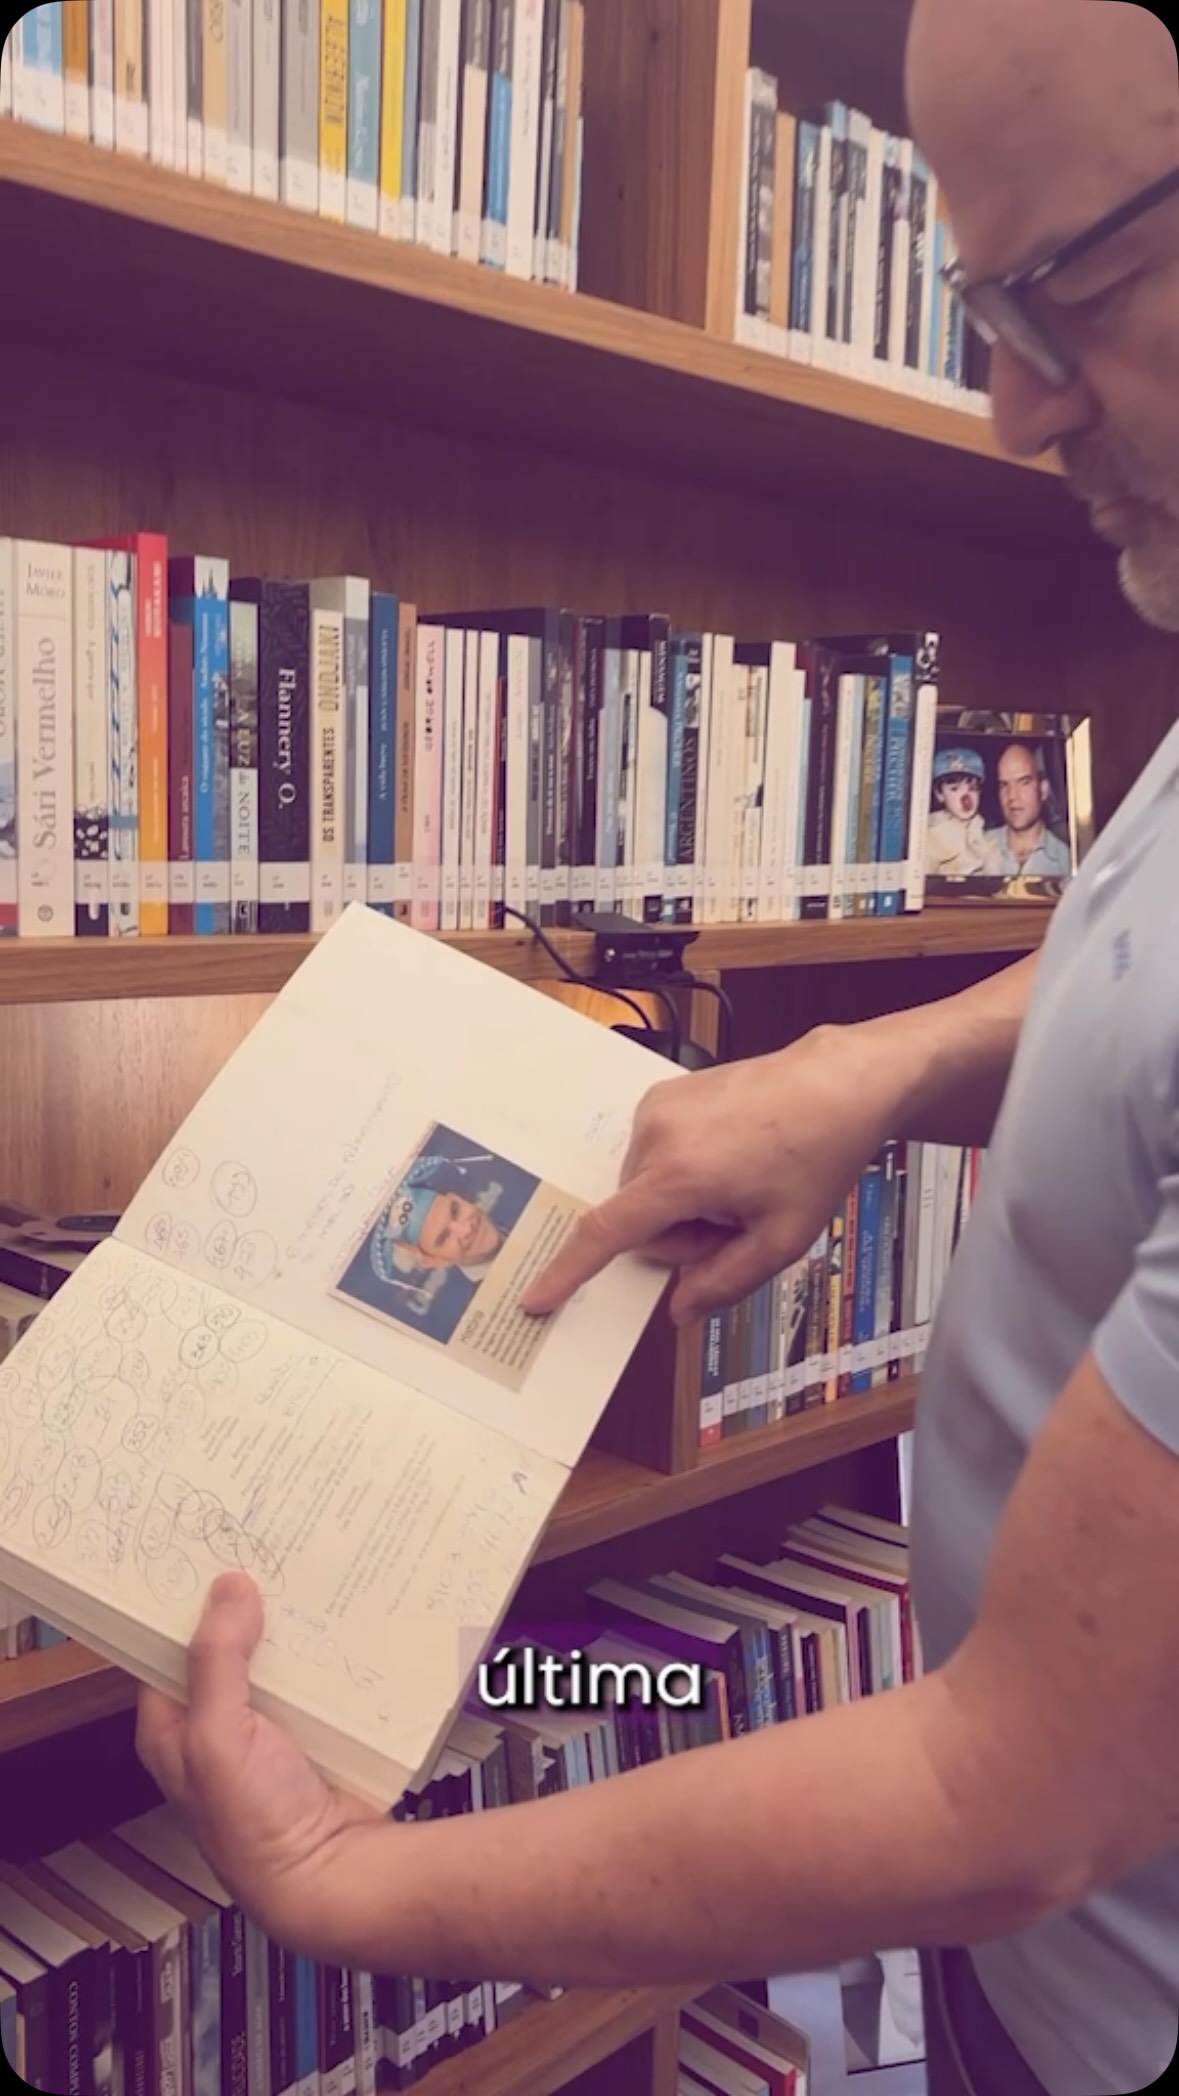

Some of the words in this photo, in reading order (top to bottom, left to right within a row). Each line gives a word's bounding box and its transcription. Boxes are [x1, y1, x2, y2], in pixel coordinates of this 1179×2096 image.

[318, 625, 340, 713] ONDJAKI
[32, 637, 57, 780] Vermelho
[237, 709, 249, 723] A
[273, 668, 296, 775] Flannery
[237, 729, 250, 765] LUZ
[322, 728, 335, 823] TRANSPARENTES
[33, 789, 57, 850] Sári
[238, 792, 251, 856] NOITE
[278, 782, 297, 810] O.
[680, 737, 695, 860] ARGENTINOS
[322, 827, 335, 843] OS
[68, 1981, 80, 2043] CONTOS
